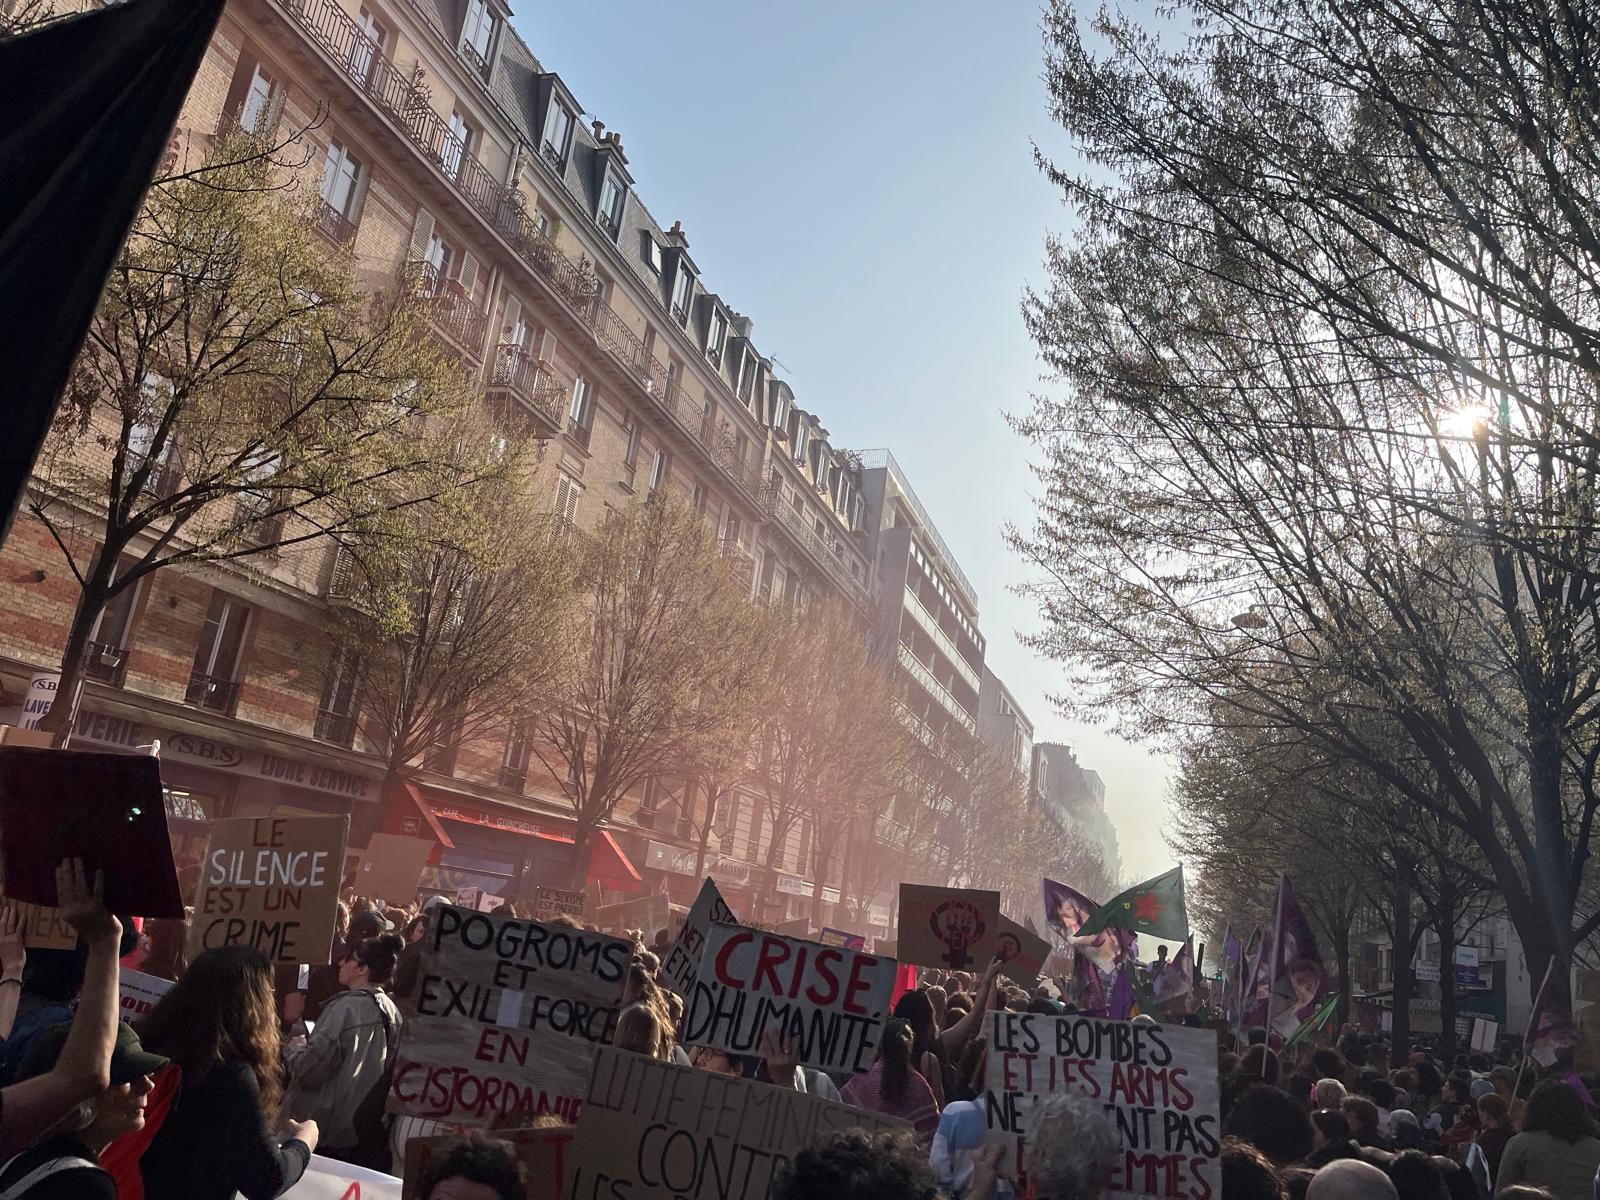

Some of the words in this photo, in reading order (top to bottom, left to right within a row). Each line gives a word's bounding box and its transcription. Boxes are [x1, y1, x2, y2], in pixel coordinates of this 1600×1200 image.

[259, 755, 305, 783] LIBRE
[310, 767, 369, 797] SERVICE
[253, 818, 287, 847] LE
[210, 849, 328, 886] SILENCE
[203, 887, 249, 914] EST
[264, 888, 302, 911] UN
[202, 918, 300, 961] CRIME
[435, 906, 629, 982] POGROMS
[493, 960, 537, 990] ET
[715, 933, 879, 1014] CRISE
[416, 975, 497, 1025] EXIL
[475, 1028, 530, 1067] EN
[685, 981, 881, 1073] D'HUMANITÉ
[994, 1014, 1040, 1053] LES
[1055, 1018, 1172, 1066] BOMBES
[587, 1050, 692, 1126] LUTTE
[1003, 1053, 1038, 1092] ET
[1109, 1062, 1194, 1111] ARMS
[986, 1089, 1025, 1134] NE
[1163, 1110, 1220, 1158] PAS
